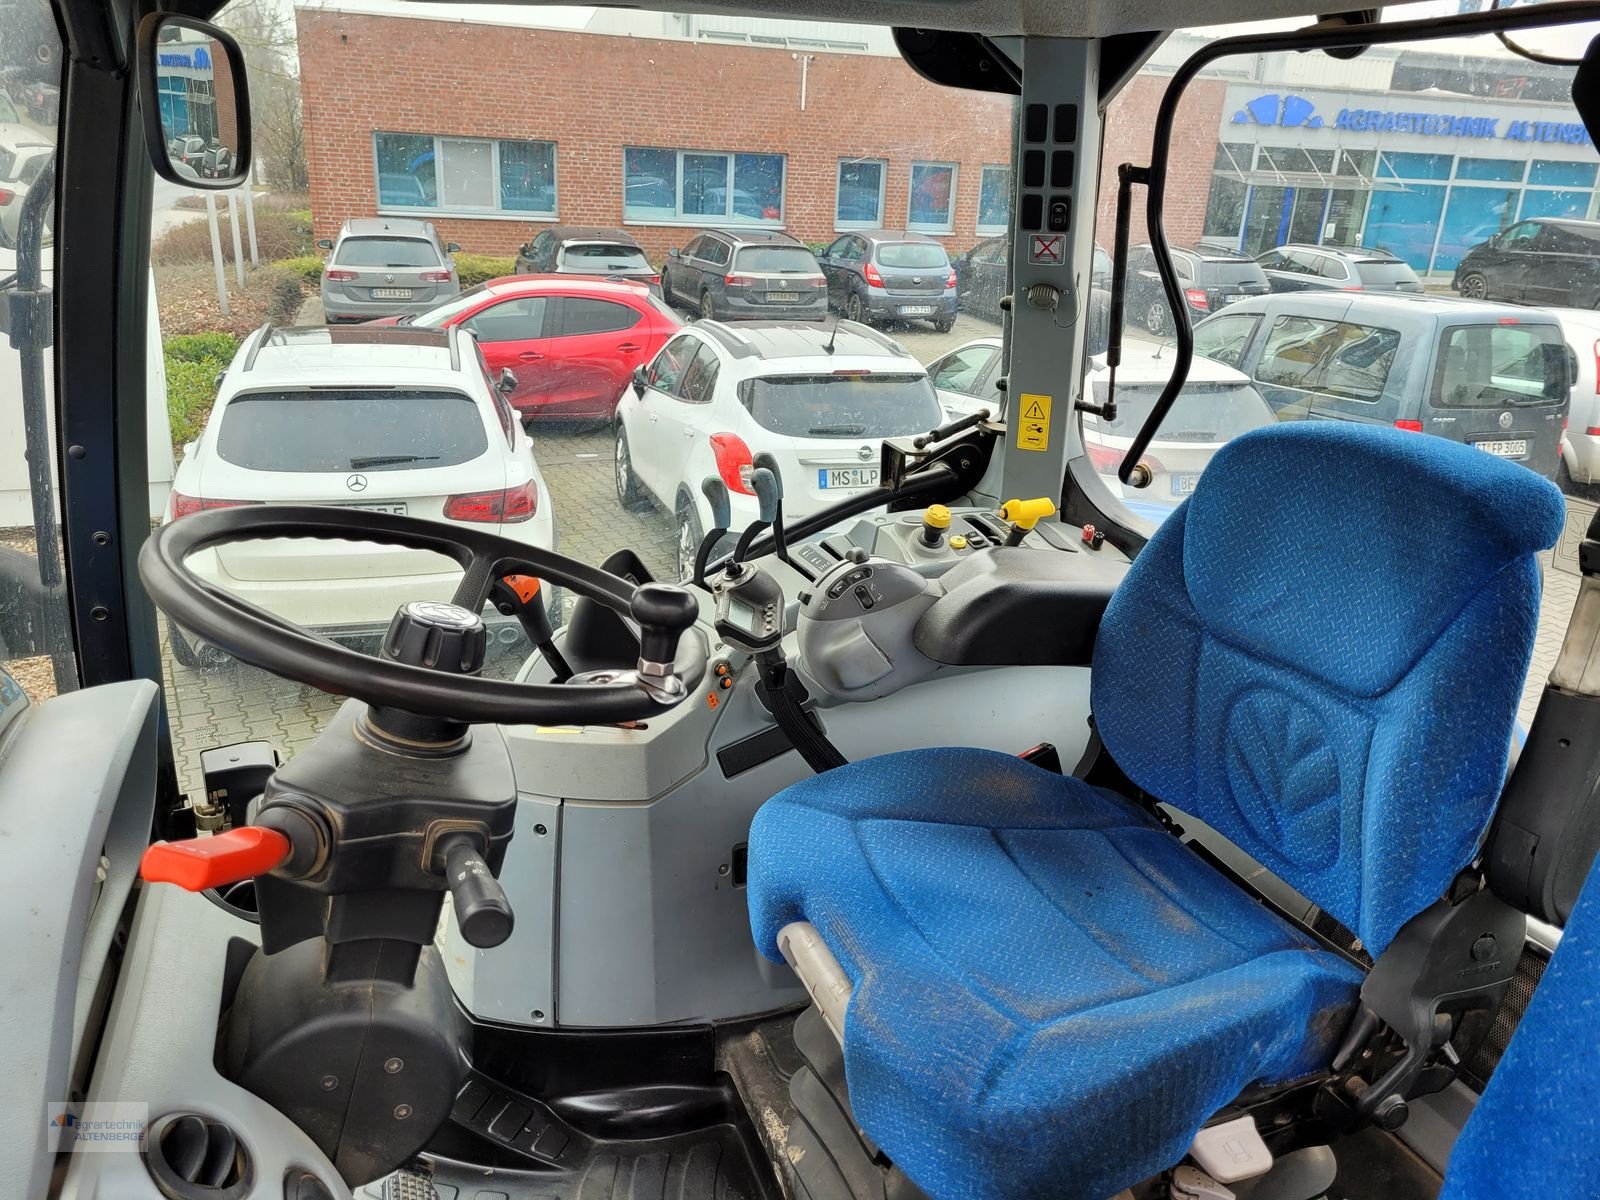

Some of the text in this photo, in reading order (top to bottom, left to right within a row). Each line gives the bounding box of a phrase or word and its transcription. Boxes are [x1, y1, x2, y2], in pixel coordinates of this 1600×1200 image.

[1334, 108, 1499, 138] AGRARTECHNIK
[1492, 443, 1502, 454] FP
[1504, 441, 1525, 454] 3005
[831, 469, 878, 486] MS LP
